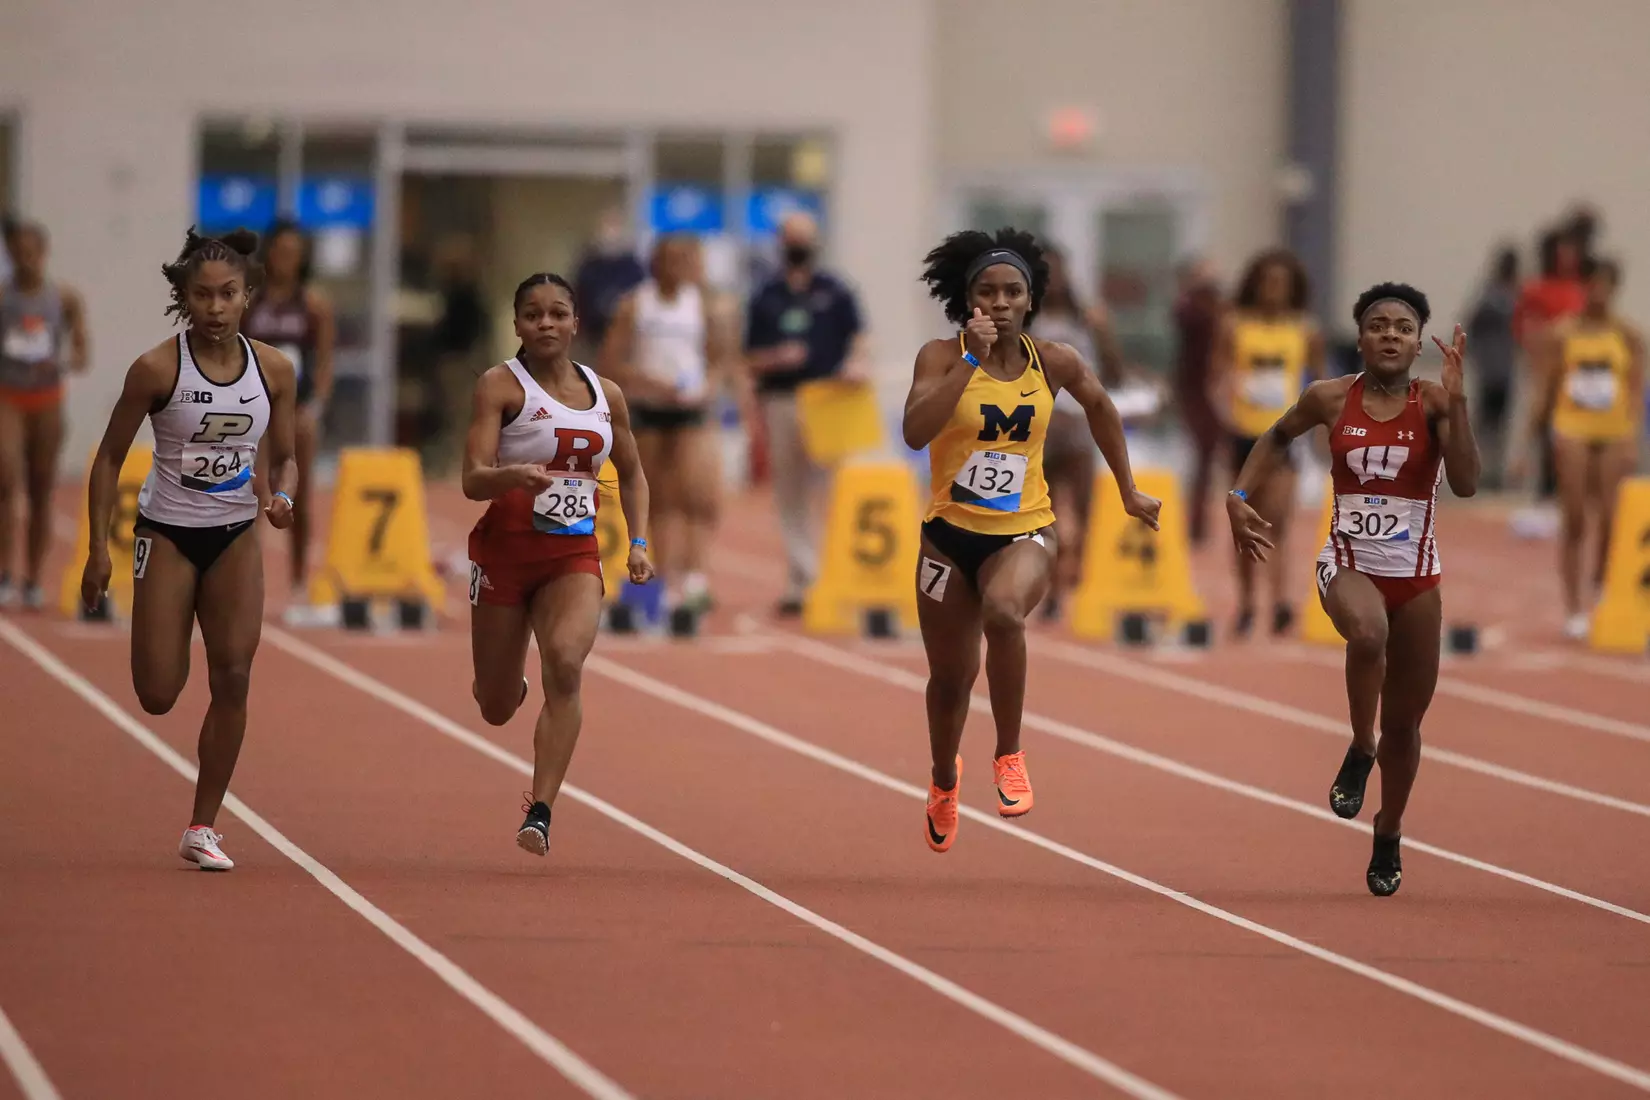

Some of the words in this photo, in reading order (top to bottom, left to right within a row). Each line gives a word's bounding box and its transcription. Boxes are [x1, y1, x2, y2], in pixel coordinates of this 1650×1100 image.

[190, 412, 253, 443] P
[977, 404, 1035, 442] M
[193, 451, 242, 477] 264
[546, 427, 605, 473] R
[1346, 445, 1410, 486] W
[967, 465, 1014, 494] 132
[359, 487, 399, 556] 7
[545, 493, 589, 518] 285
[1348, 511, 1399, 537] 302
[853, 498, 897, 567] 5
[135, 539, 147, 576] 9
[469, 564, 478, 601] 8
[925, 562, 946, 594] 7
